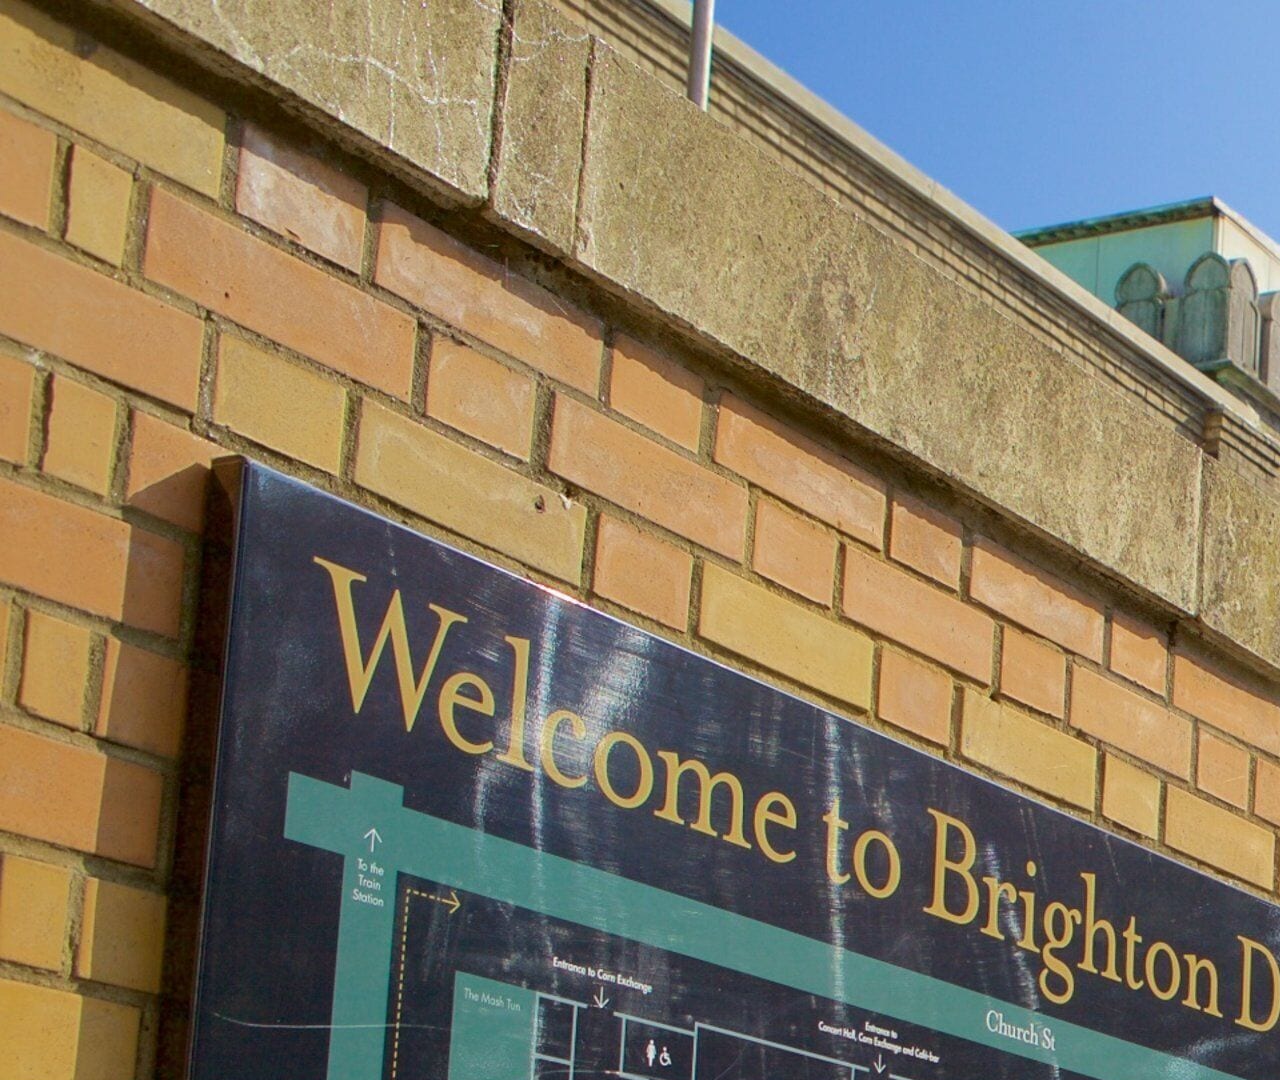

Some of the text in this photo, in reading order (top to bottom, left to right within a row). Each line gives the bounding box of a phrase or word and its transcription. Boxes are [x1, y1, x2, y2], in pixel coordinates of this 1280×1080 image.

[313, 556, 798, 864] Welcome
[822, 798, 901, 900] to
[922, 806, 1224, 1019] Brighton
[357, 858, 384, 875] To the
[358, 874, 381, 891] Train
[352, 888, 384, 908] Station
[553, 956, 652, 995] Entrance to Corn Exchange
[464, 987, 521, 1012] The Mash Tun
[986, 1010, 1056, 1051] Church St
